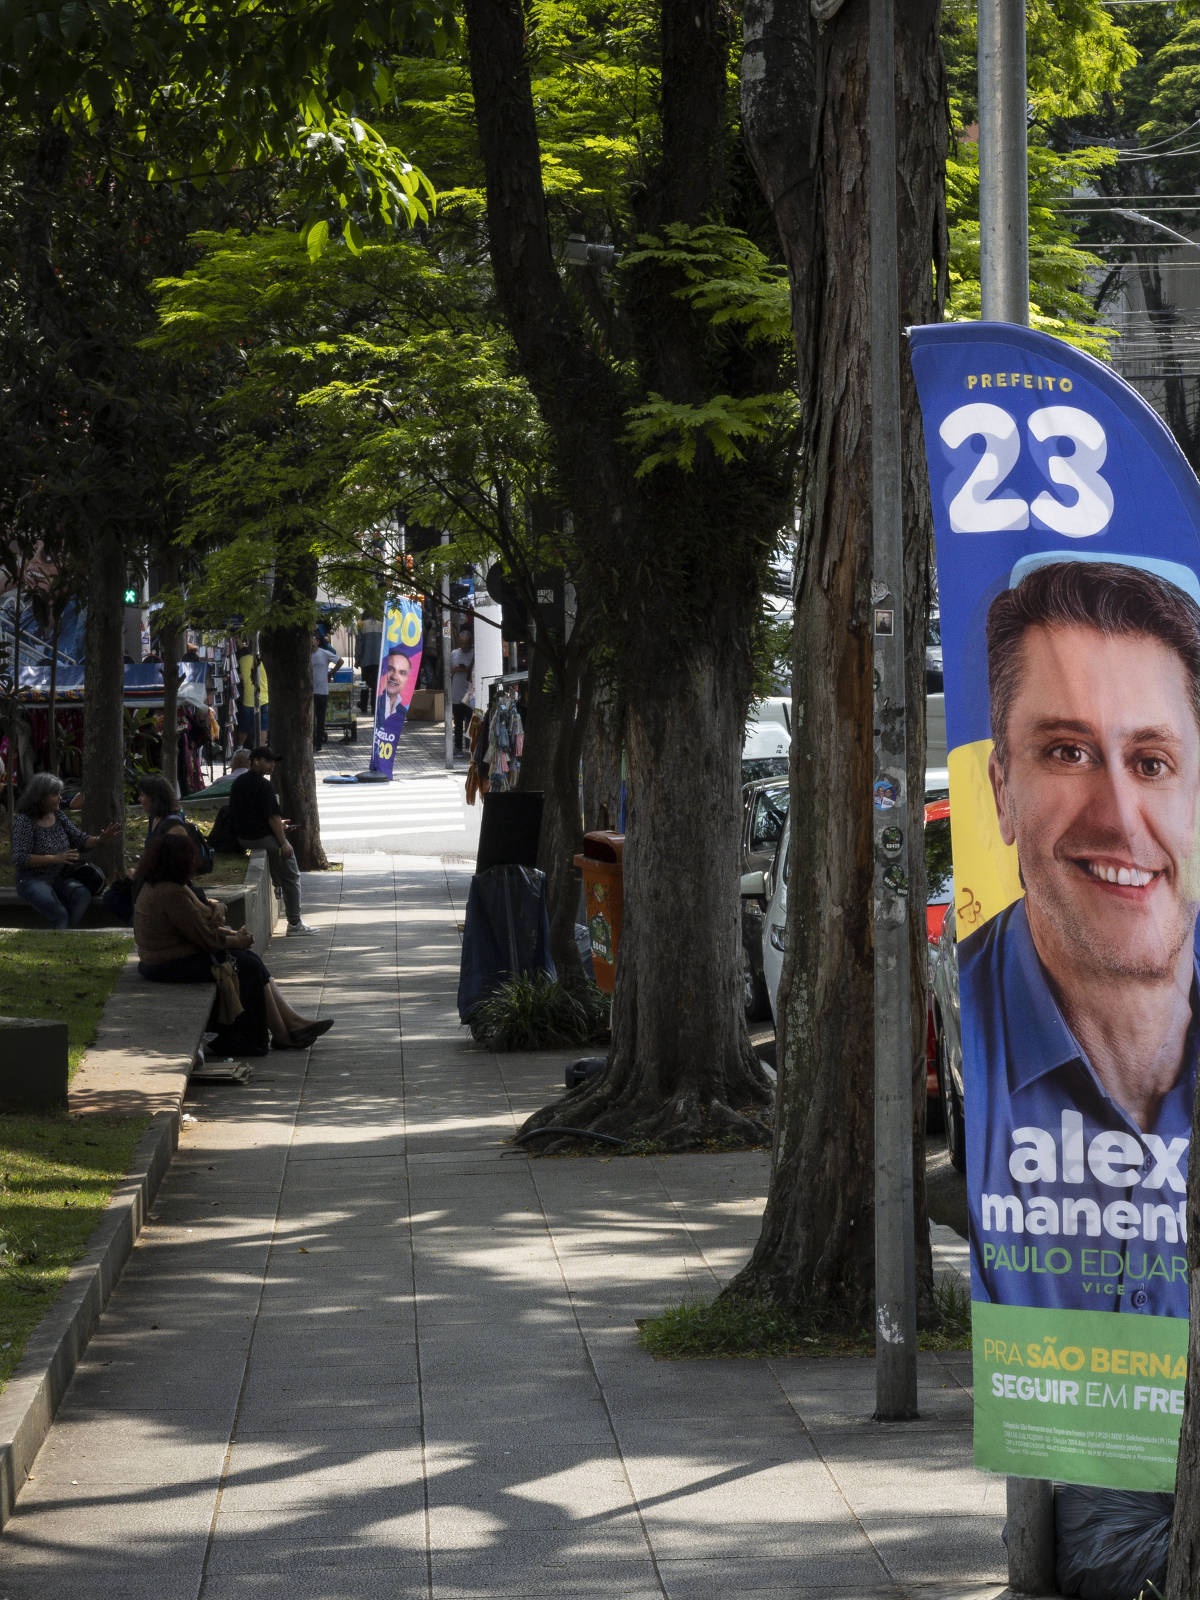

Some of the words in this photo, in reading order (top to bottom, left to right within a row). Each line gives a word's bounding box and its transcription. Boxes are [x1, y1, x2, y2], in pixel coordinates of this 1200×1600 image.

[967, 372, 1074, 393] PREFEITO
[939, 402, 1115, 538] 23
[387, 609, 422, 647] 20
[1008, 1108, 1189, 1194] alex
[983, 1242, 1072, 1275] PAULO
[1081, 1249, 1189, 1283] EDUAR
[1082, 1282, 1126, 1295] VICE
[984, 1338, 1024, 1367] PRA
[1027, 1336, 1086, 1372] SÃO
[1091, 1348, 1188, 1379] BERNA
[991, 1372, 1080, 1406] SEGUIR
[1085, 1381, 1127, 1409] EM
[1133, 1386, 1185, 1415] FRE
